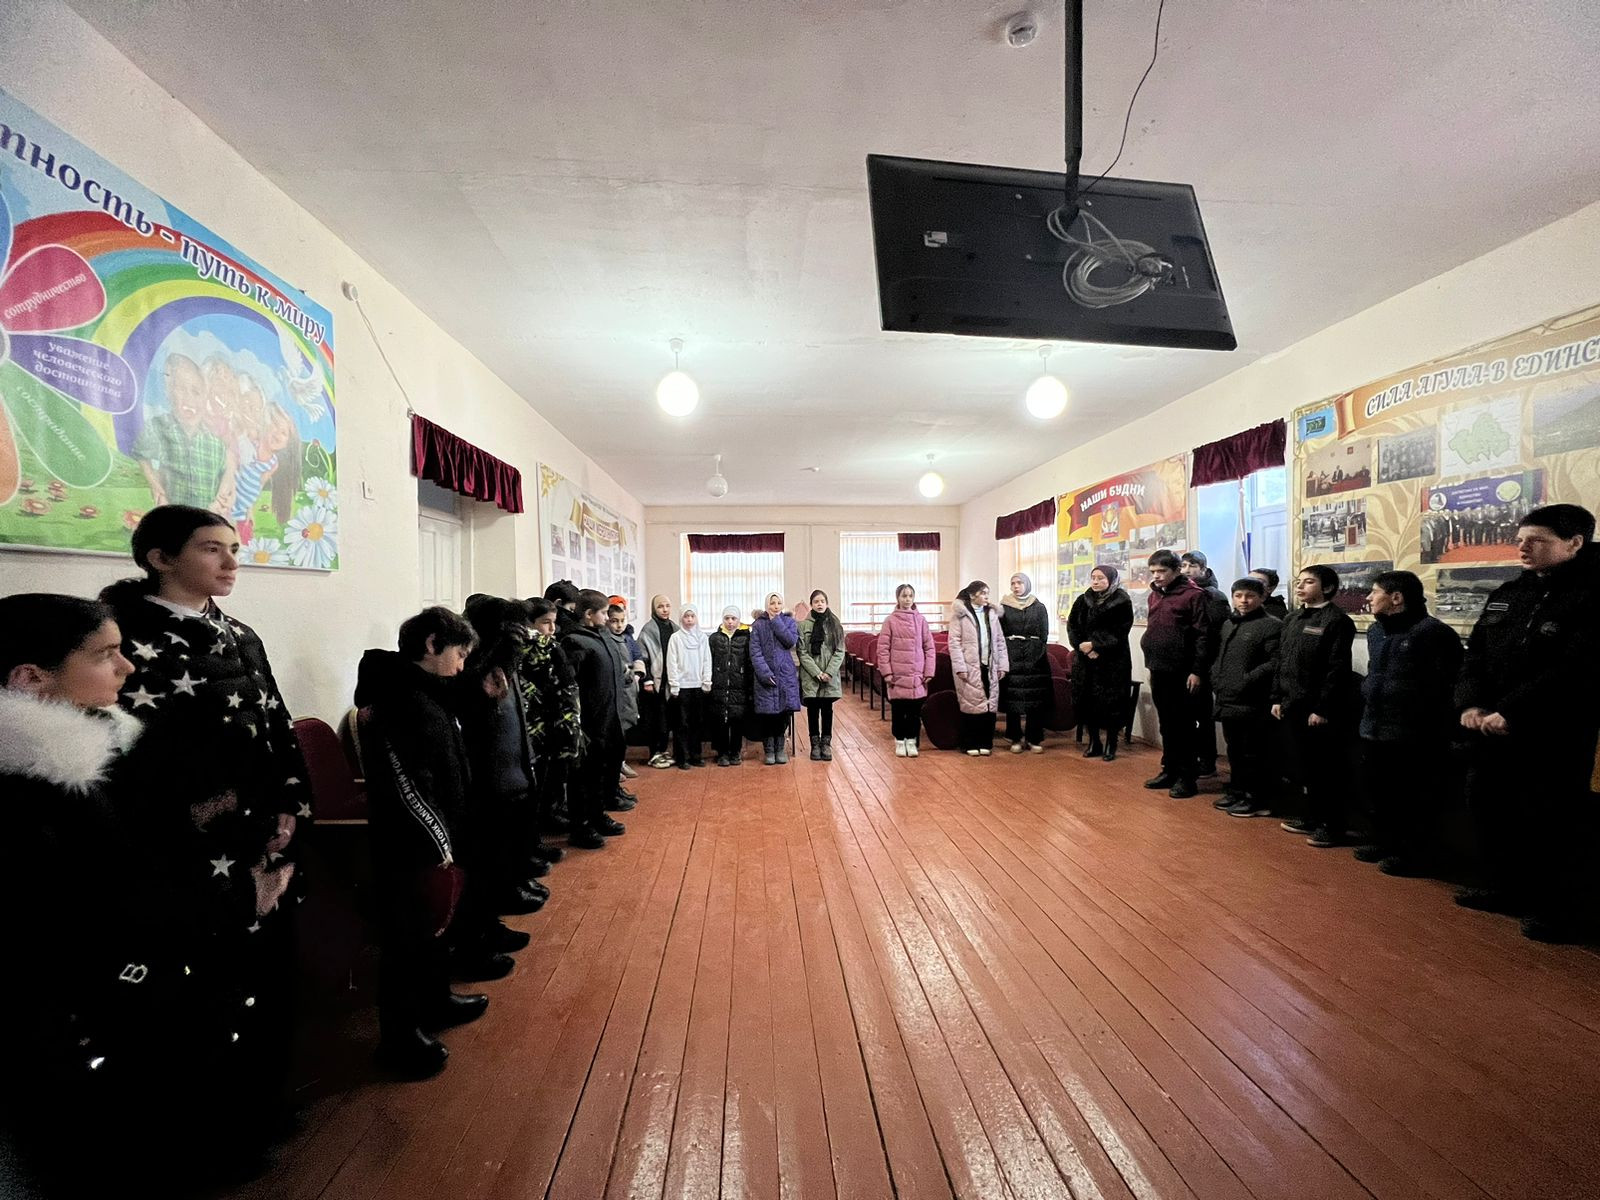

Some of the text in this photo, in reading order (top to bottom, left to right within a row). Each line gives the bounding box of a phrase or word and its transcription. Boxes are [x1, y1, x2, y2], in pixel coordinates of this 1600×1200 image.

[4, 273, 87, 319] сотрудничество
[182, 238, 249, 294] путь
[257, 286, 270, 308] к
[276, 299, 325, 343] миру
[33, 350, 122, 386] человеческого
[48, 342, 110, 370] уважение
[1367, 382, 1412, 416] СИЛА
[1080, 483, 1145, 512] НАШИ БУДНИ
[406, 792, 434, 826] YANKEES
[431, 822, 446, 844] YORK
